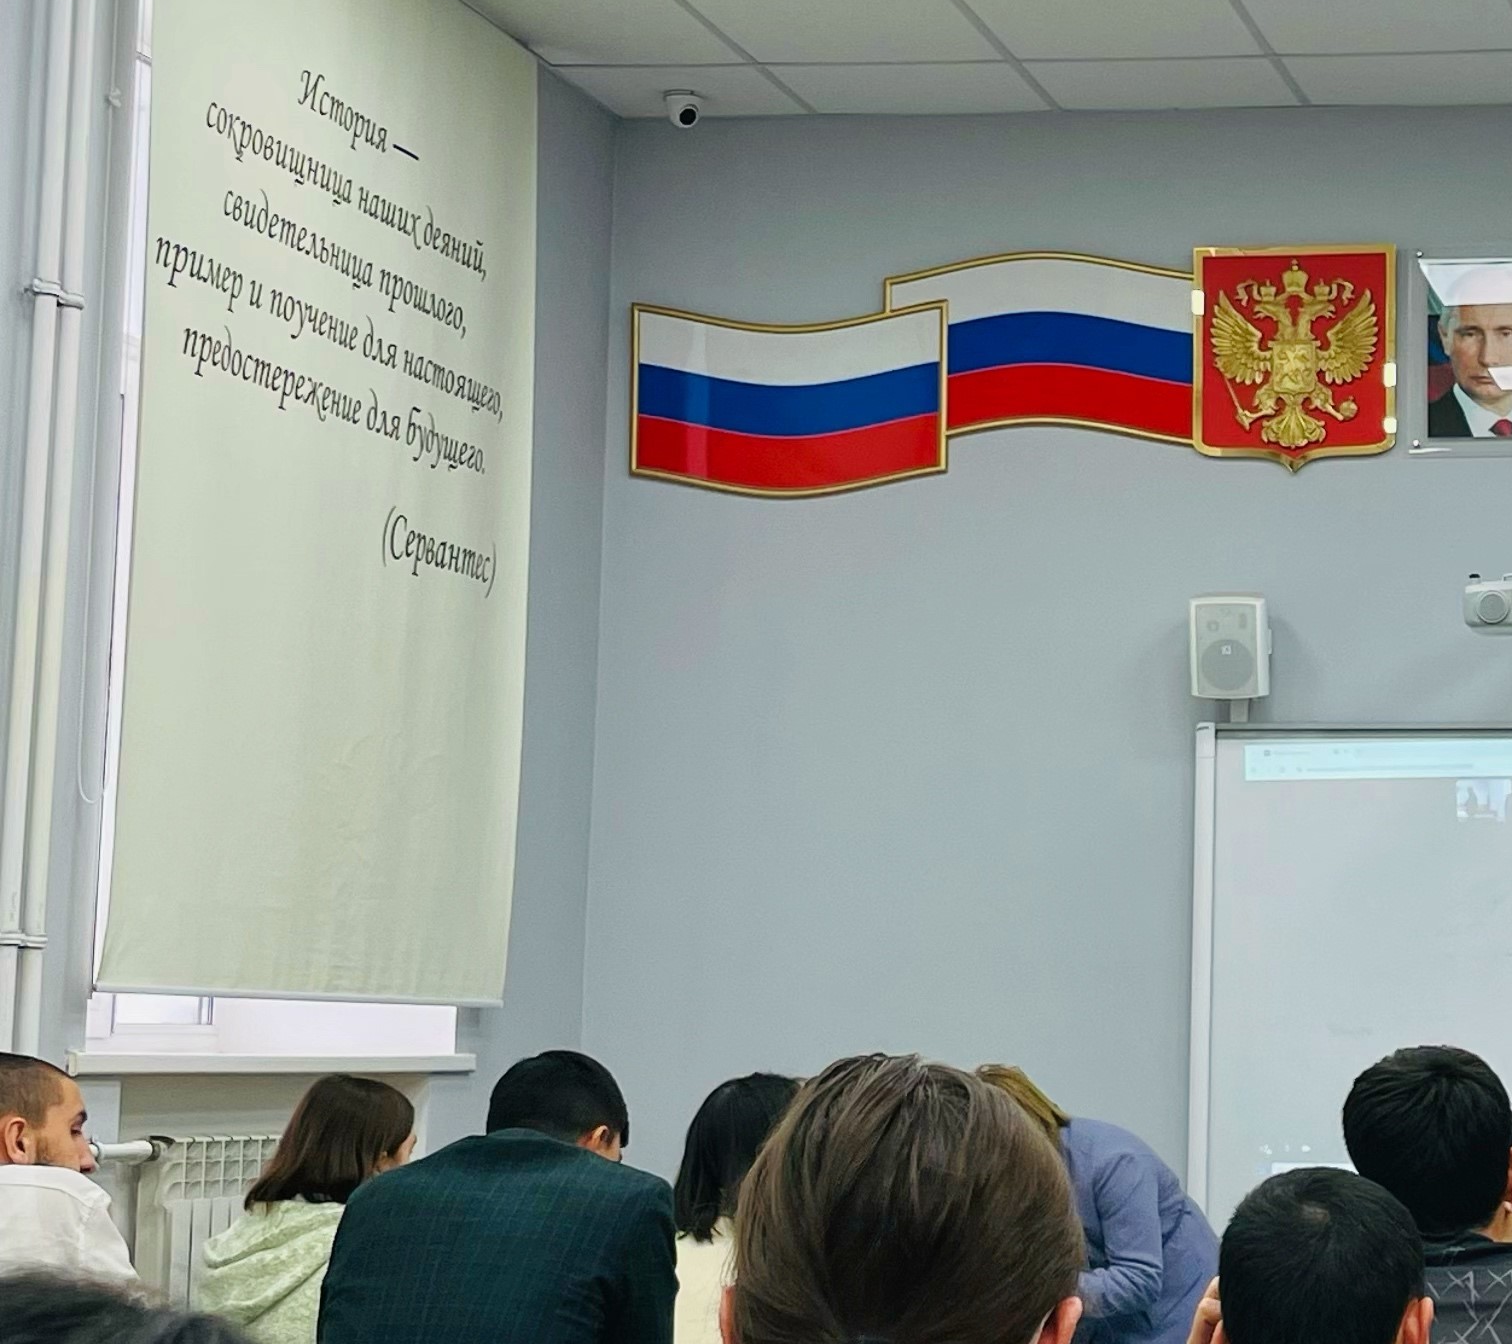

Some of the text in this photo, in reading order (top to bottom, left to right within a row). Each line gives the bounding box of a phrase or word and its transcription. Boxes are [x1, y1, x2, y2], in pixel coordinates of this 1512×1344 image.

[298, 70, 388, 152] История
[206, 102, 487, 282] сокровищница наших деяний,
[224, 188, 467, 340] свидетельница прошлого,
[156, 237, 503, 424] пример и поучение для настоящего,
[183, 325, 486, 475] предостережение для будущего.
[383, 506, 497, 599] (Сервантес)
